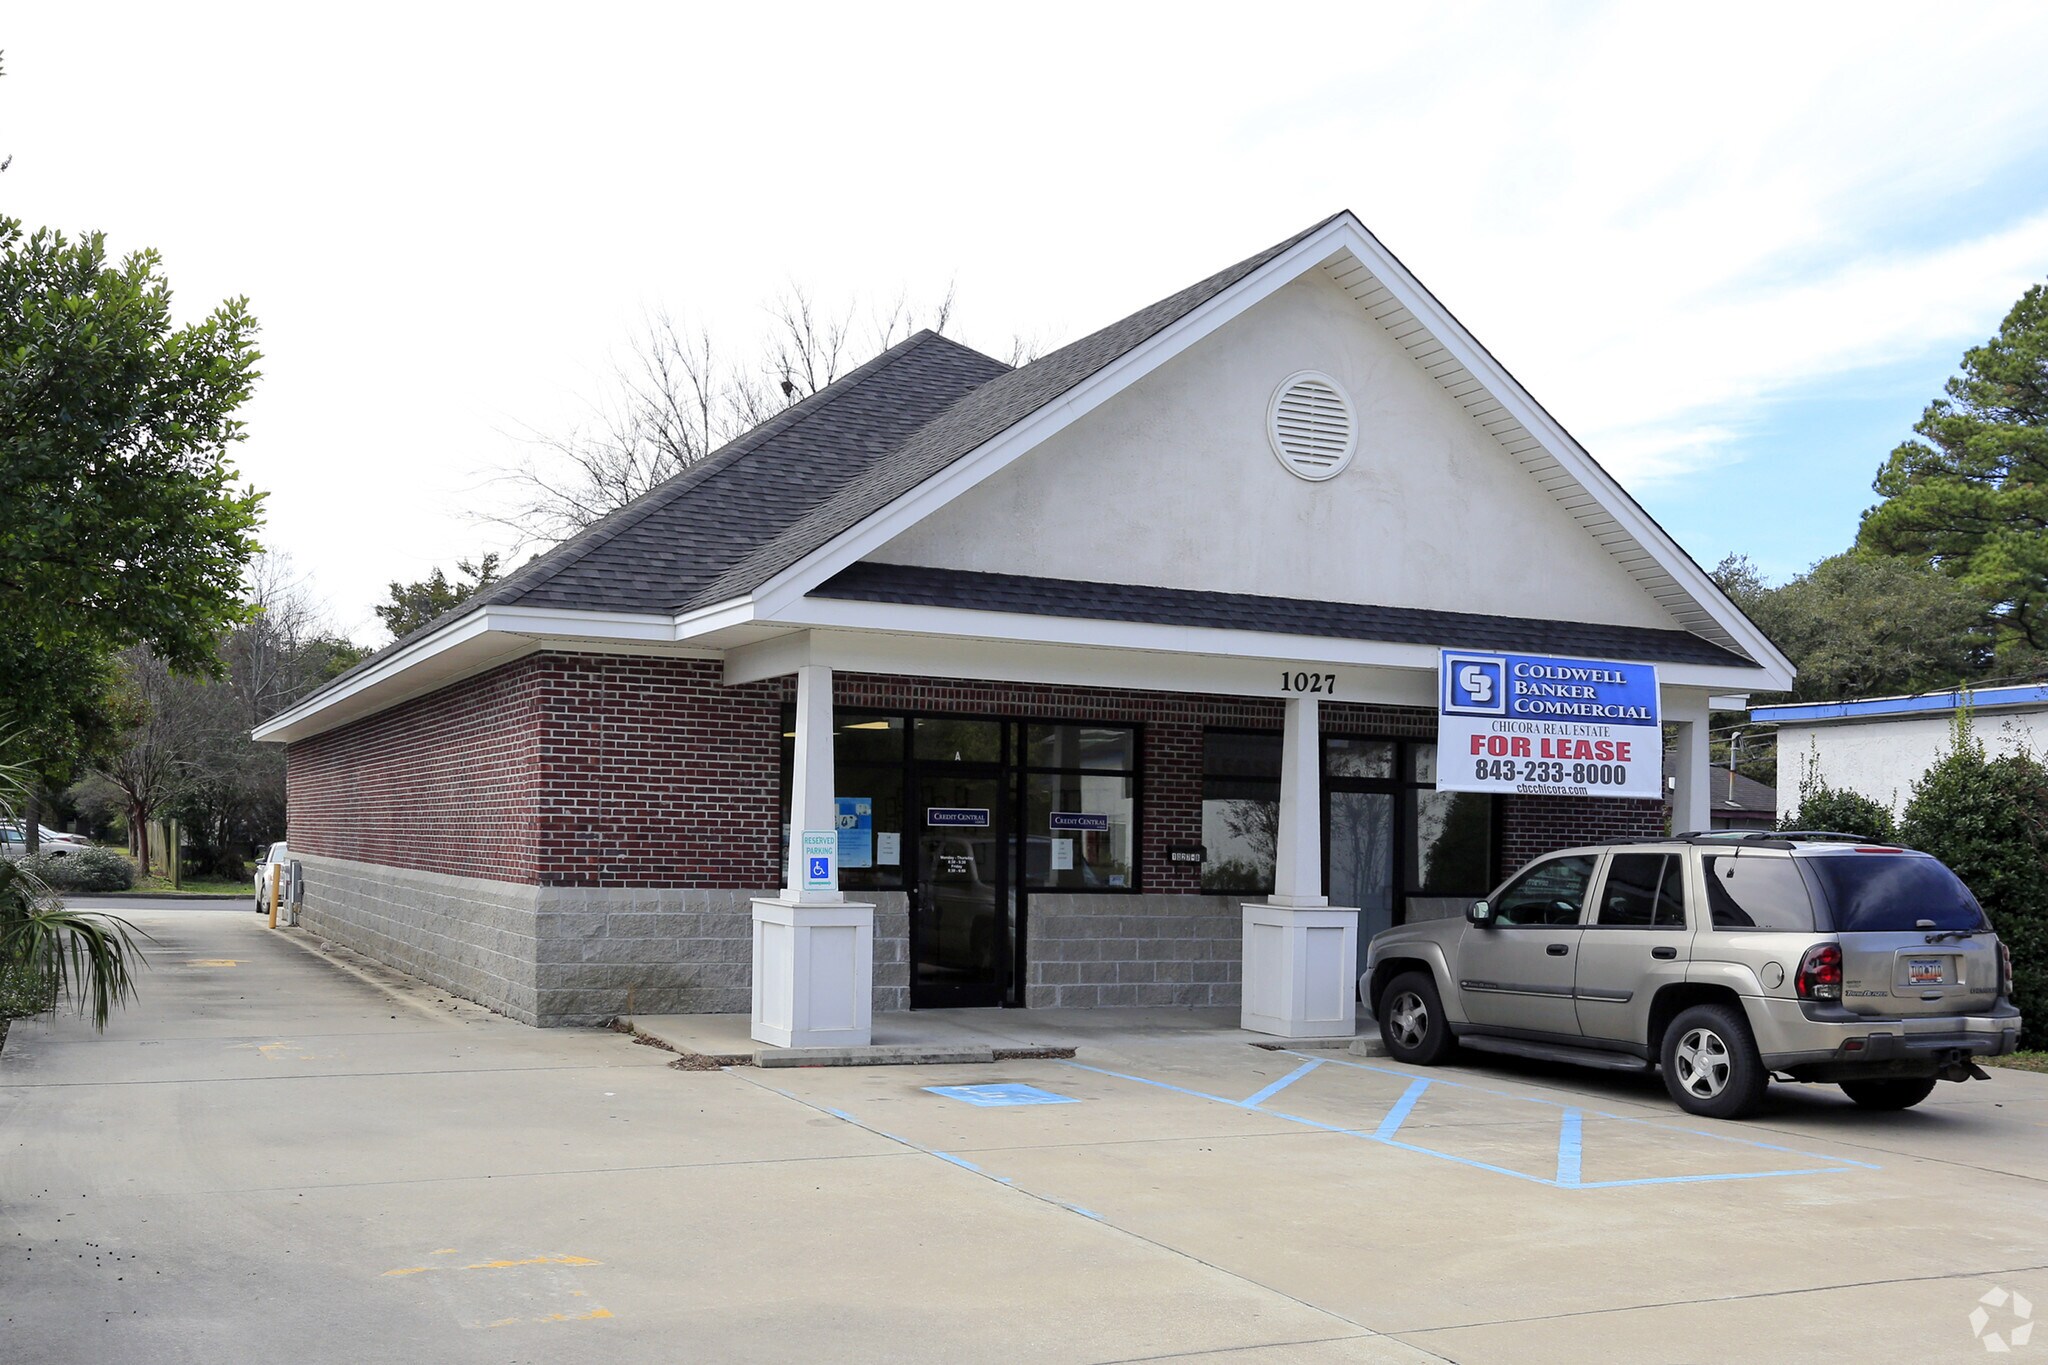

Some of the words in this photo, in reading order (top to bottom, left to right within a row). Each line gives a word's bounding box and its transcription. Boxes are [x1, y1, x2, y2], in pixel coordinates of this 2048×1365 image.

[1513, 662, 1627, 684] COLDWELL
[1281, 671, 1336, 694] 1027
[1513, 680, 1597, 699] BANKER
[1513, 698, 1652, 720] COMMERCIAL
[1491, 720, 1541, 734] CHICORA
[1543, 724, 1572, 736] REAL
[1573, 726, 1611, 738] ESTATE
[954, 751, 961, 761] A
[1470, 734, 1531, 758] FOR
[1540, 738, 1632, 762] LEASE
[1475, 759, 1626, 785] 843-233-8000
[1516, 783, 1588, 795] cbcchicora.com
[933, 812, 957, 821] CREDIT
[957, 813, 985, 821] CENTRAL
[1055, 816, 1077, 825] CREDIT
[1077, 817, 1106, 826] CENTRAL
[804, 836, 835, 845] RESERVED
[806, 847, 833, 855] PARKING
